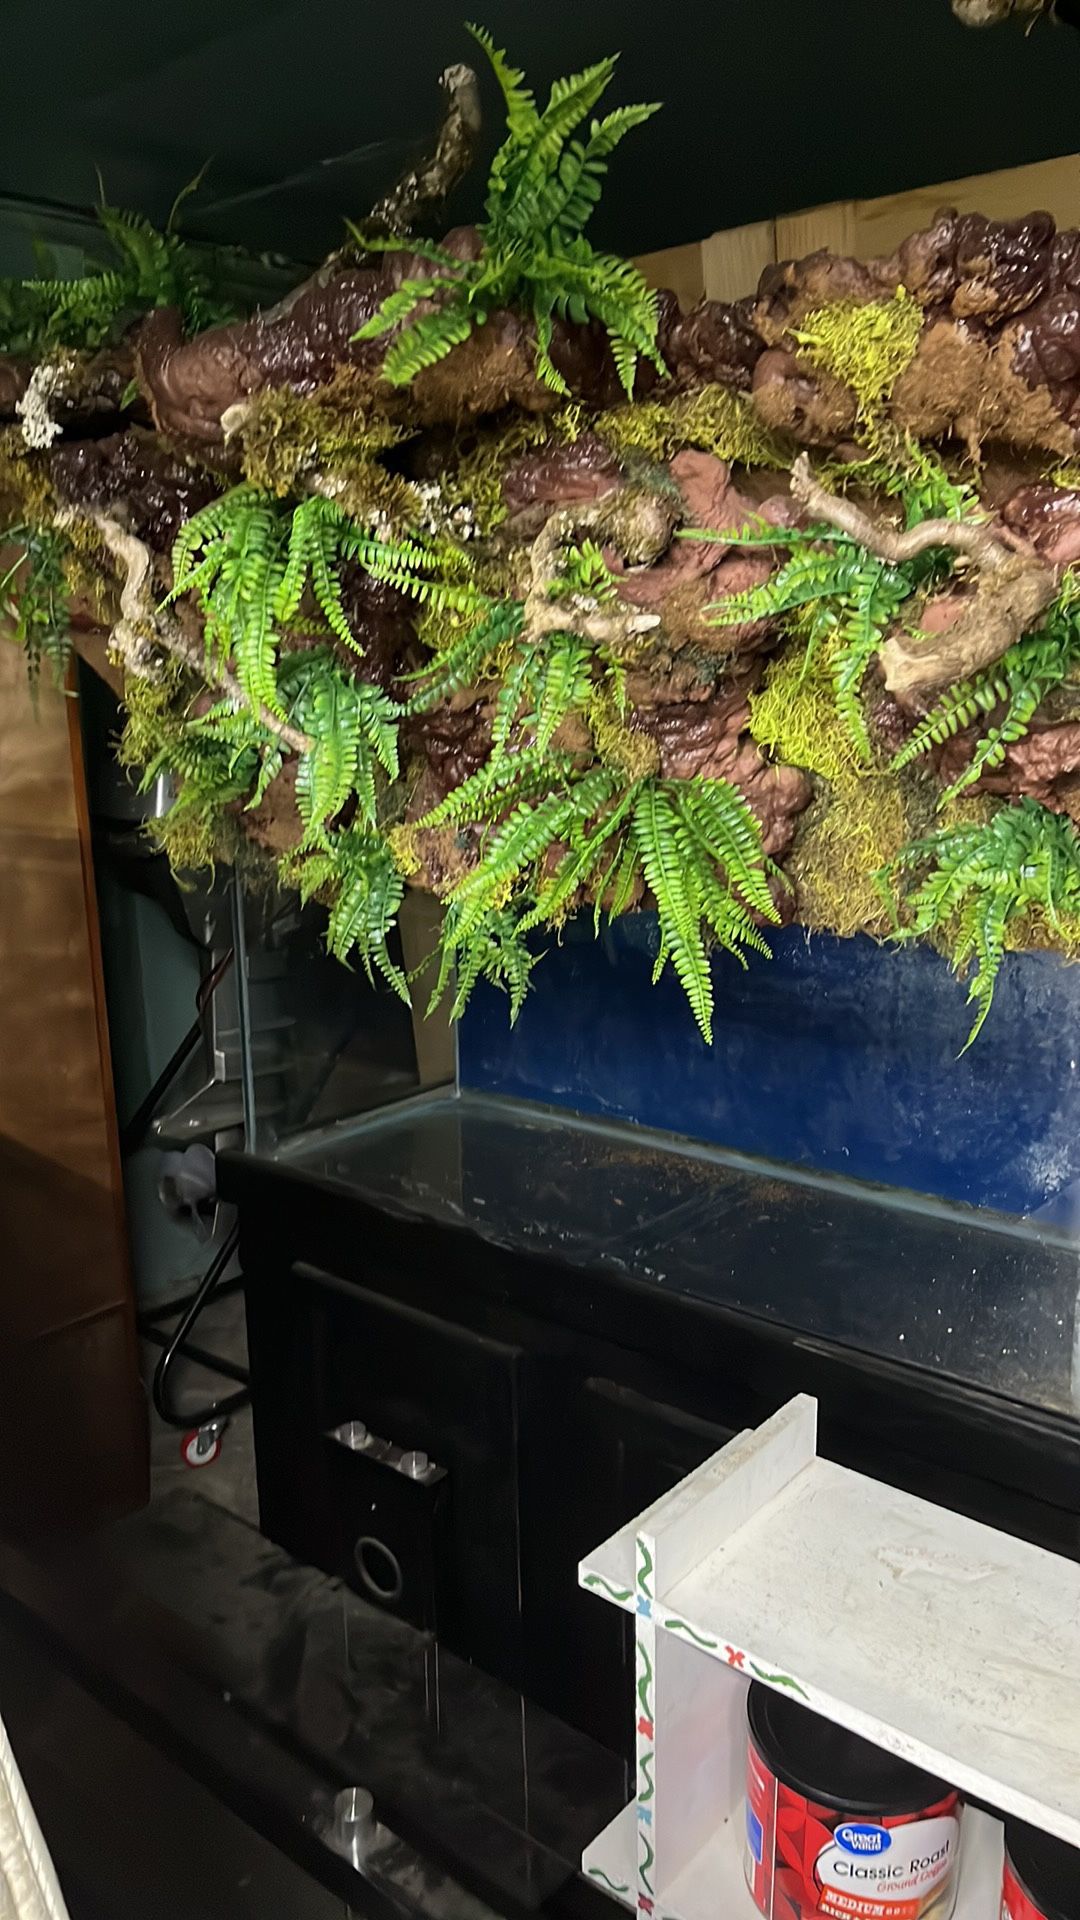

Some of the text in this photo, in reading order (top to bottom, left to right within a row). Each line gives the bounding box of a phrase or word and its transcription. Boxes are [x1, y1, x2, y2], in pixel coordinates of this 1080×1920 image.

[842, 1828, 882, 1844] Great
[852, 1840, 882, 1851] Value
[833, 1839, 950, 1880] Classic Roast
[876, 1873, 919, 1892] Ground
[825, 1889, 885, 1916] MEDIUM
